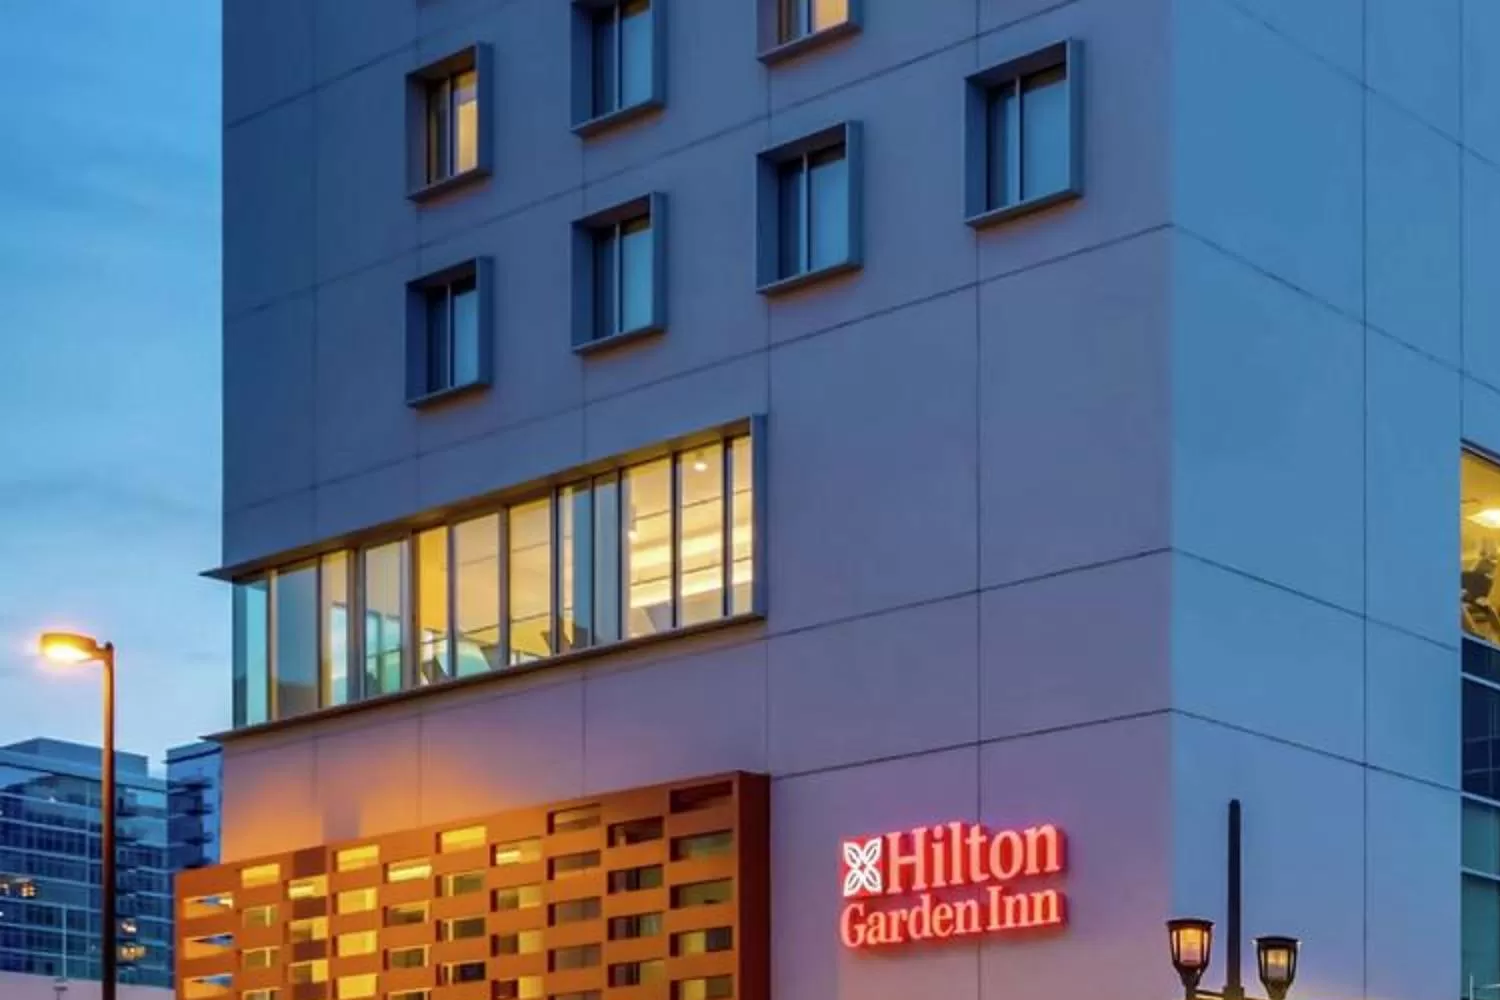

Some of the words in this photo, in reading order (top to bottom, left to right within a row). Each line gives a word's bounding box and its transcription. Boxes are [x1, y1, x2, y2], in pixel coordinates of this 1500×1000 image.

[887, 822, 1059, 892] Hilton
[841, 894, 981, 948] Garden
[986, 884, 1061, 931] Inn
